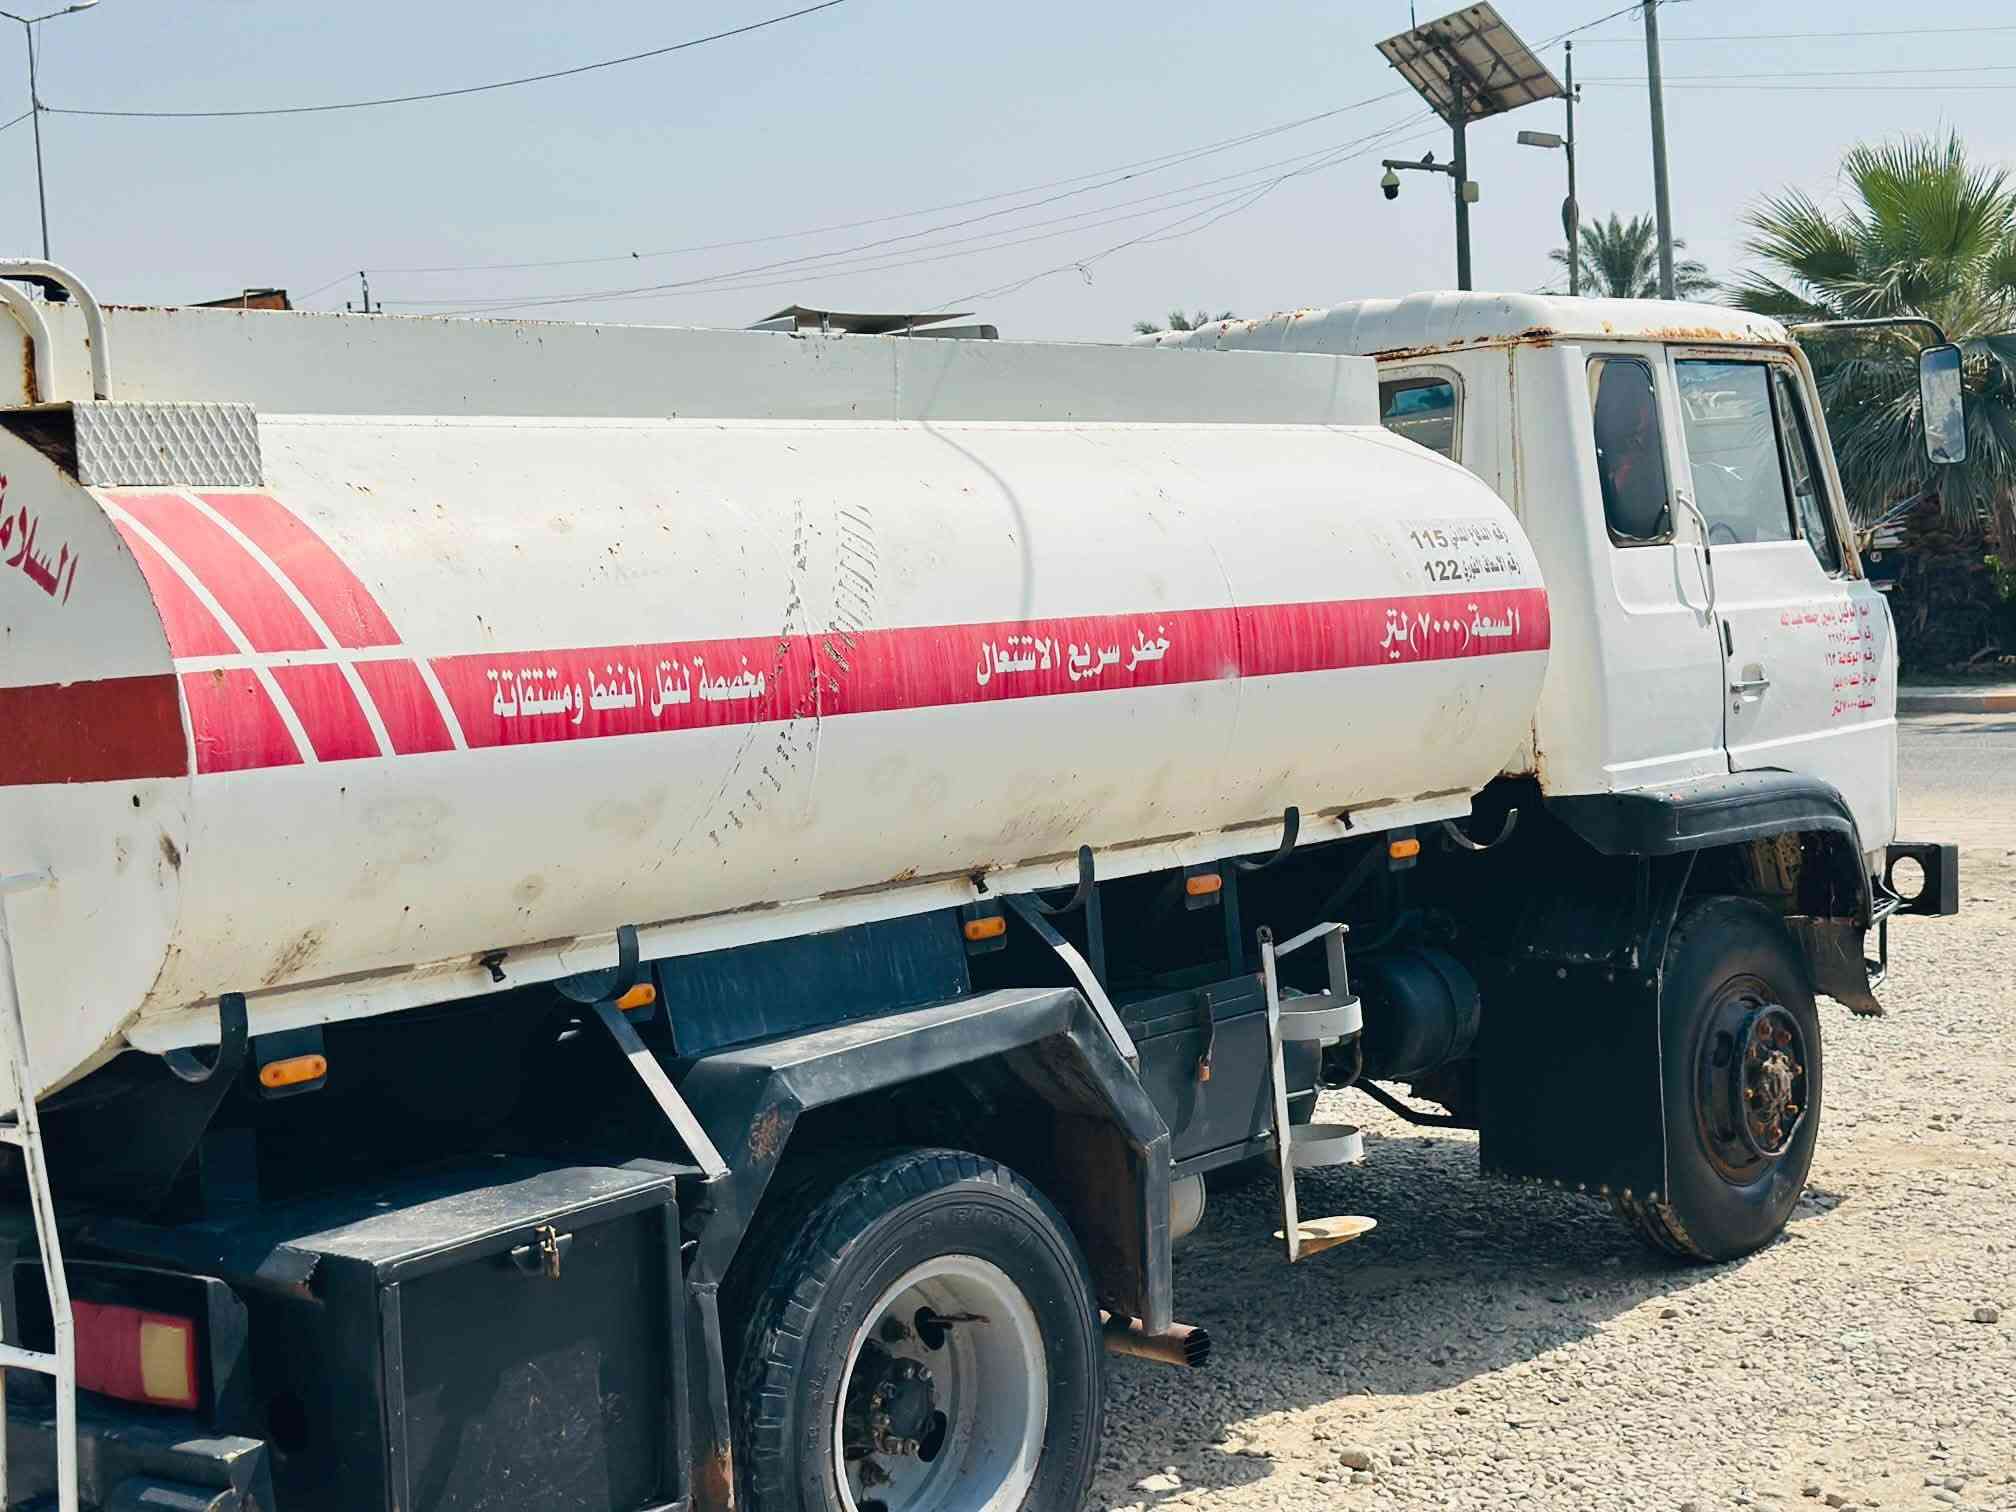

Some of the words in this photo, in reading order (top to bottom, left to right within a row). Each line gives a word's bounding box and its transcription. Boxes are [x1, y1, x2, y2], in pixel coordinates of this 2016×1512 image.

[0, 473, 79, 606] السلام
[1410, 529, 1448, 550] 115
[1424, 560, 1462, 582] 122
[1467, 603, 1521, 637] السعة
[976, 635, 1061, 686] الاشتعال
[1067, 641, 1120, 681] سريع
[1125, 624, 1170, 672] خطر
[588, 663, 644, 711] النفط
[651, 659, 691, 717] لنقل
[693, 655, 766, 702] مخصصة
